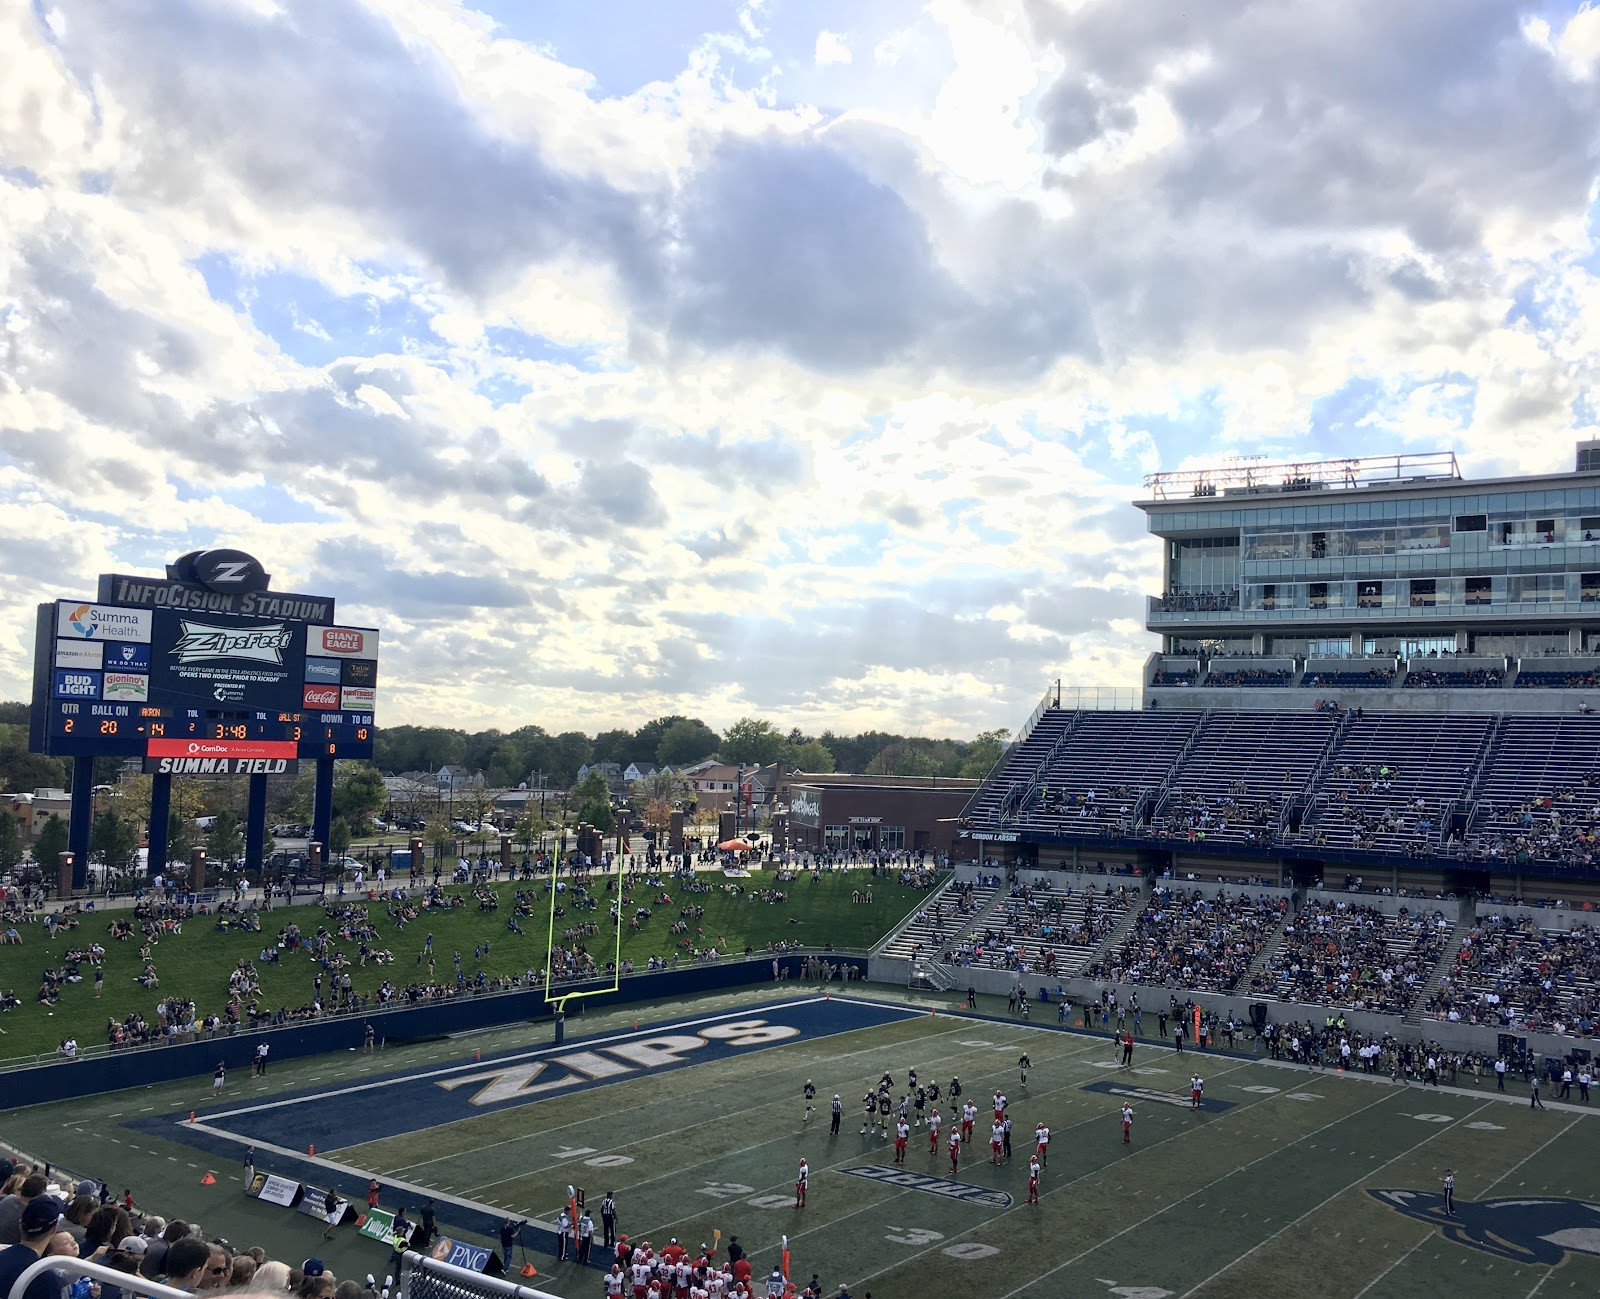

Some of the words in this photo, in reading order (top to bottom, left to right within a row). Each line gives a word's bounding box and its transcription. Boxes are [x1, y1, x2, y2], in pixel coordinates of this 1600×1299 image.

[209, 562, 251, 583] Z
[241, 592, 328, 621] STADIUM
[90, 609, 139, 625] Summa
[102, 624, 138, 637] Health
[326, 631, 360, 642] GIANT
[176, 631, 292, 653] ZipsFest
[326, 640, 359, 650] EAGLE
[122, 646, 134, 655] PM
[307, 664, 340, 675] FirstEnergy
[64, 674, 92, 686] BUD
[106, 674, 145, 687] Gionino's
[58, 684, 97, 696] LIGHT
[61, 703, 80, 714] QTR
[91, 704, 114, 716] BALL
[115, 706, 129, 717] ON
[187, 709, 199, 718] TOL
[256, 711, 267, 720] TOL
[320, 713, 343, 724] DOWN
[351, 714, 361, 724] TO
[361, 715, 372, 725] GO
[64, 719, 74, 733] 2
[100, 720, 118, 734] 20
[151, 723, 165, 736] 14
[189, 722, 195, 732] 2
[215, 724, 247, 739] 3:48
[293, 726, 301, 741] 3
[356, 728, 368, 740] 10
[201, 745, 228, 753] ComDoc
[328, 743, 336, 754] 8
[159, 757, 229, 774] SUMMA
[235, 758, 288, 774] FIELD
[971, 833, 994, 841] GORDON
[434, 1019, 801, 1107] ZIPS
[449, 1244, 488, 1272] PNC
